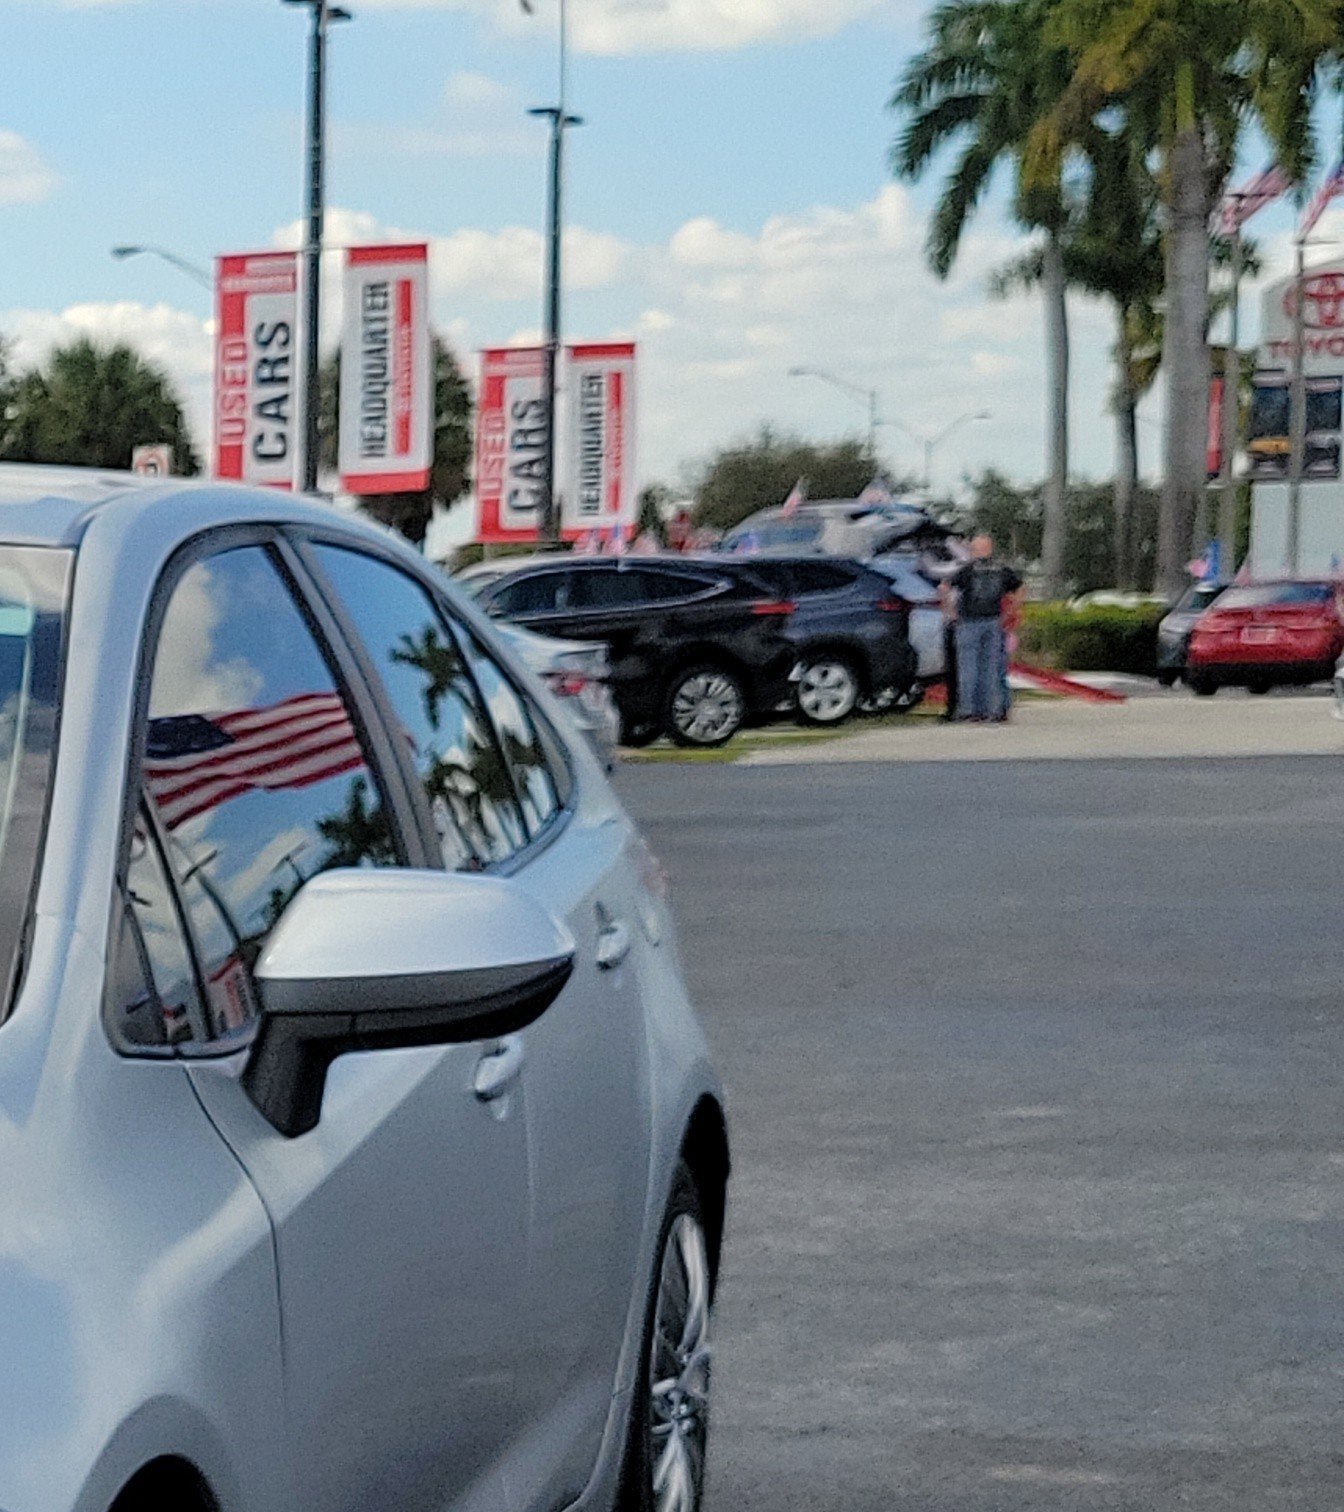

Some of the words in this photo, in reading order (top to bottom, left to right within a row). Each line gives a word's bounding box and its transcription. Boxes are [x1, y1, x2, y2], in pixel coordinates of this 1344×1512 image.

[222, 341, 247, 438] USED
[254, 321, 290, 460] CARS
[361, 281, 390, 458] HEADQUARTER
[480, 415, 506, 492] USED
[509, 399, 548, 511] CARS
